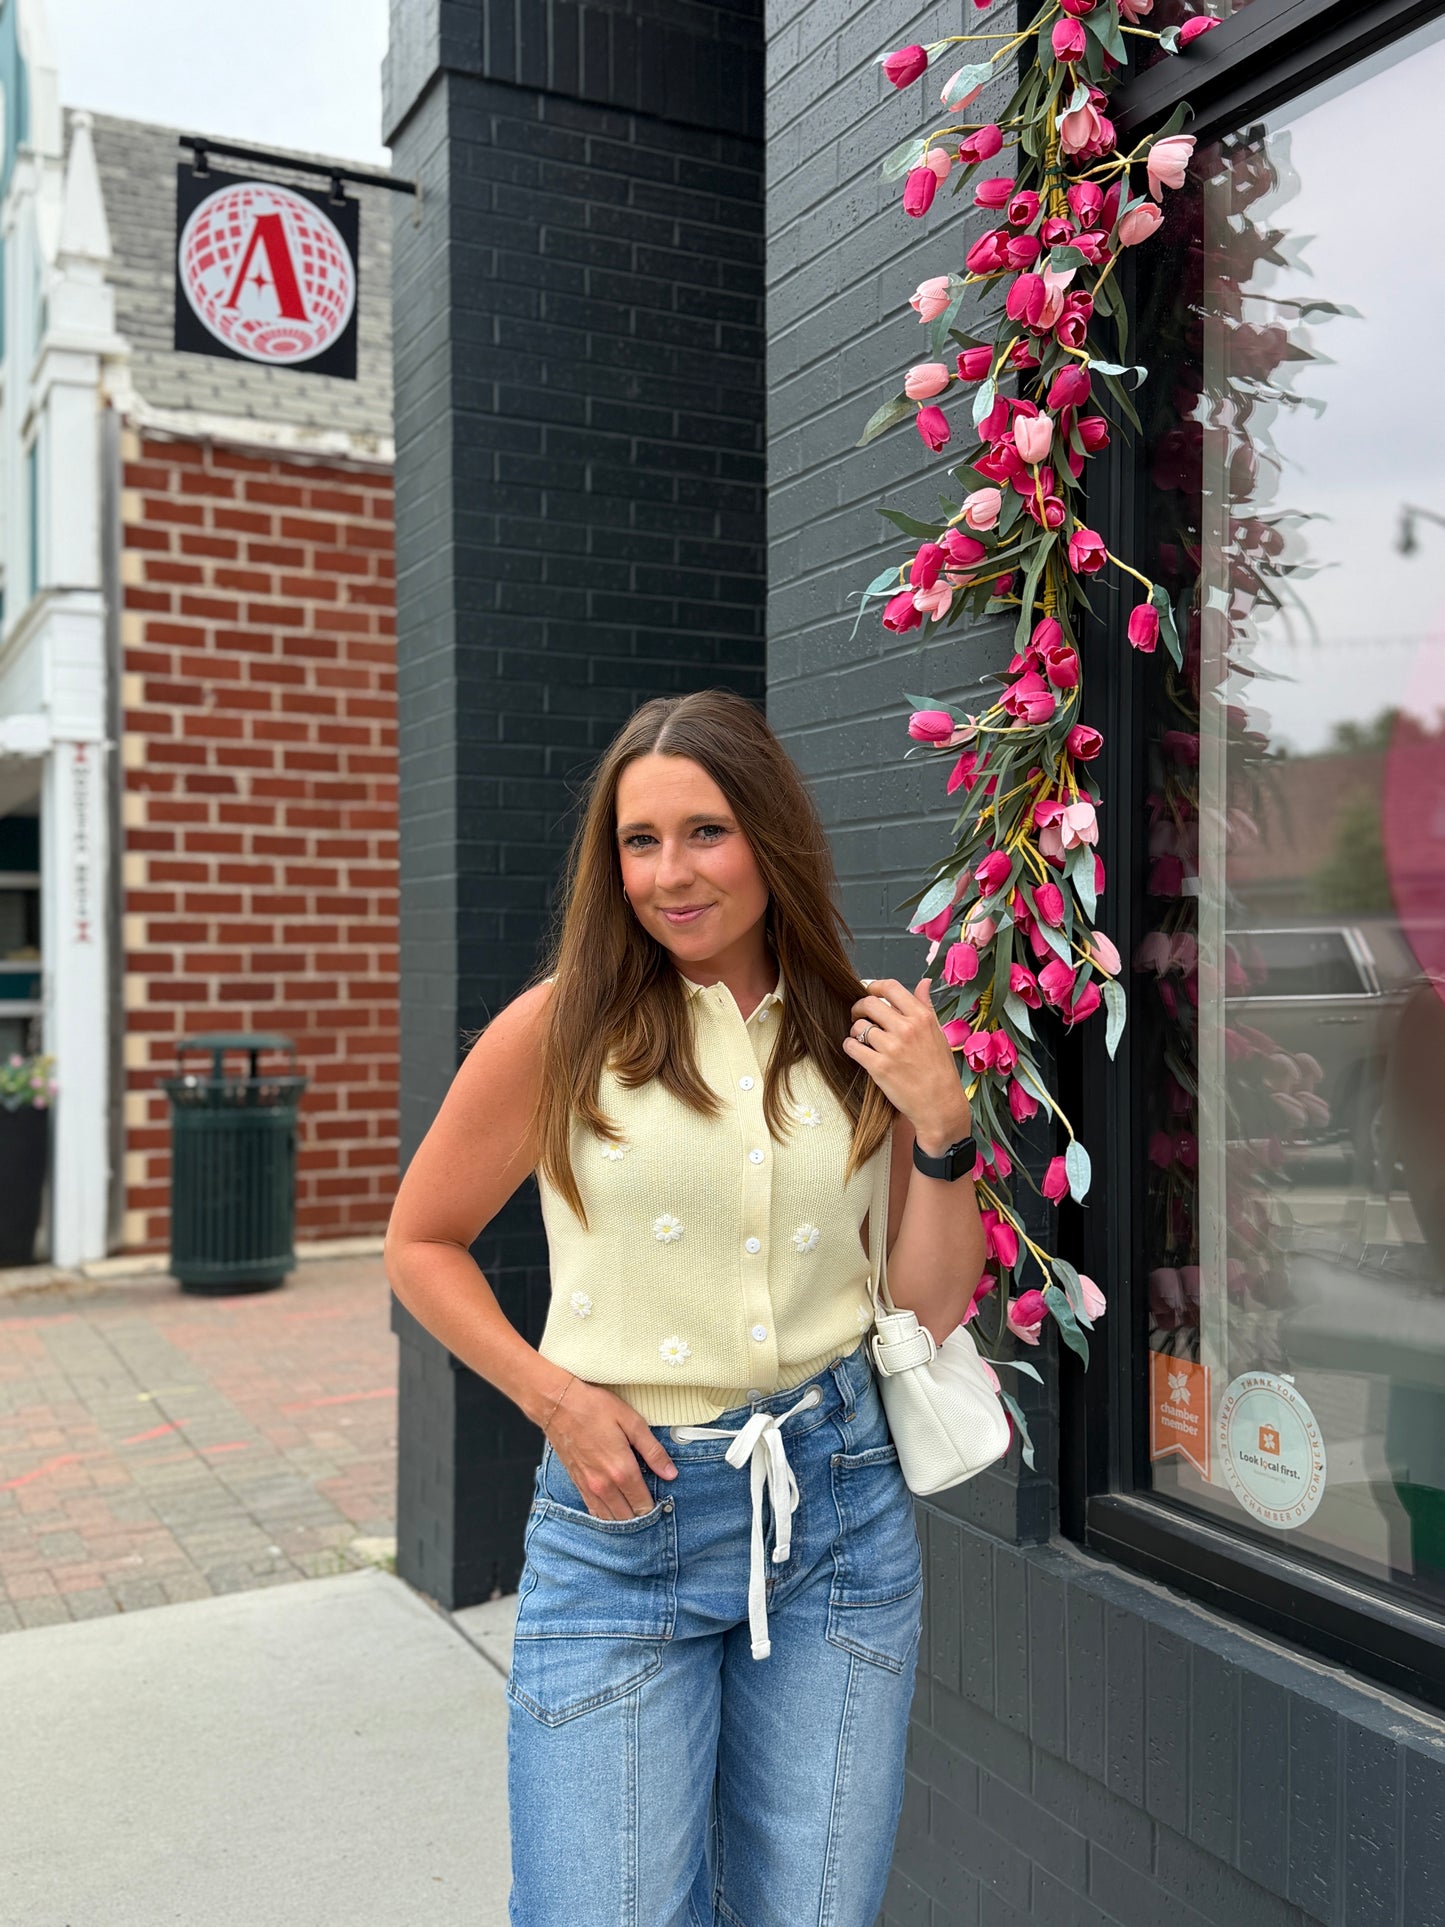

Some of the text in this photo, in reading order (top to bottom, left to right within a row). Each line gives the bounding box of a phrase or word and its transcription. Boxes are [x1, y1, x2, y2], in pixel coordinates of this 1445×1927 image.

[222, 213, 312, 323] A
[1240, 1378, 1297, 1403] THANK YOU
[1160, 1402, 1199, 1424] chamber
[1161, 1416, 1199, 1436] member
[1220, 1396, 1234, 1449] ORANGE
[1224, 1458, 1241, 1489] CITY
[1239, 1451, 1259, 1466] Look
[1260, 1458, 1279, 1473] local
[1280, 1465, 1300, 1480] first.
[1307, 1422, 1321, 1502] COMMERCE
[1242, 1493, 1292, 1522] CHAMBER
[1295, 1503, 1308, 1517] OF
